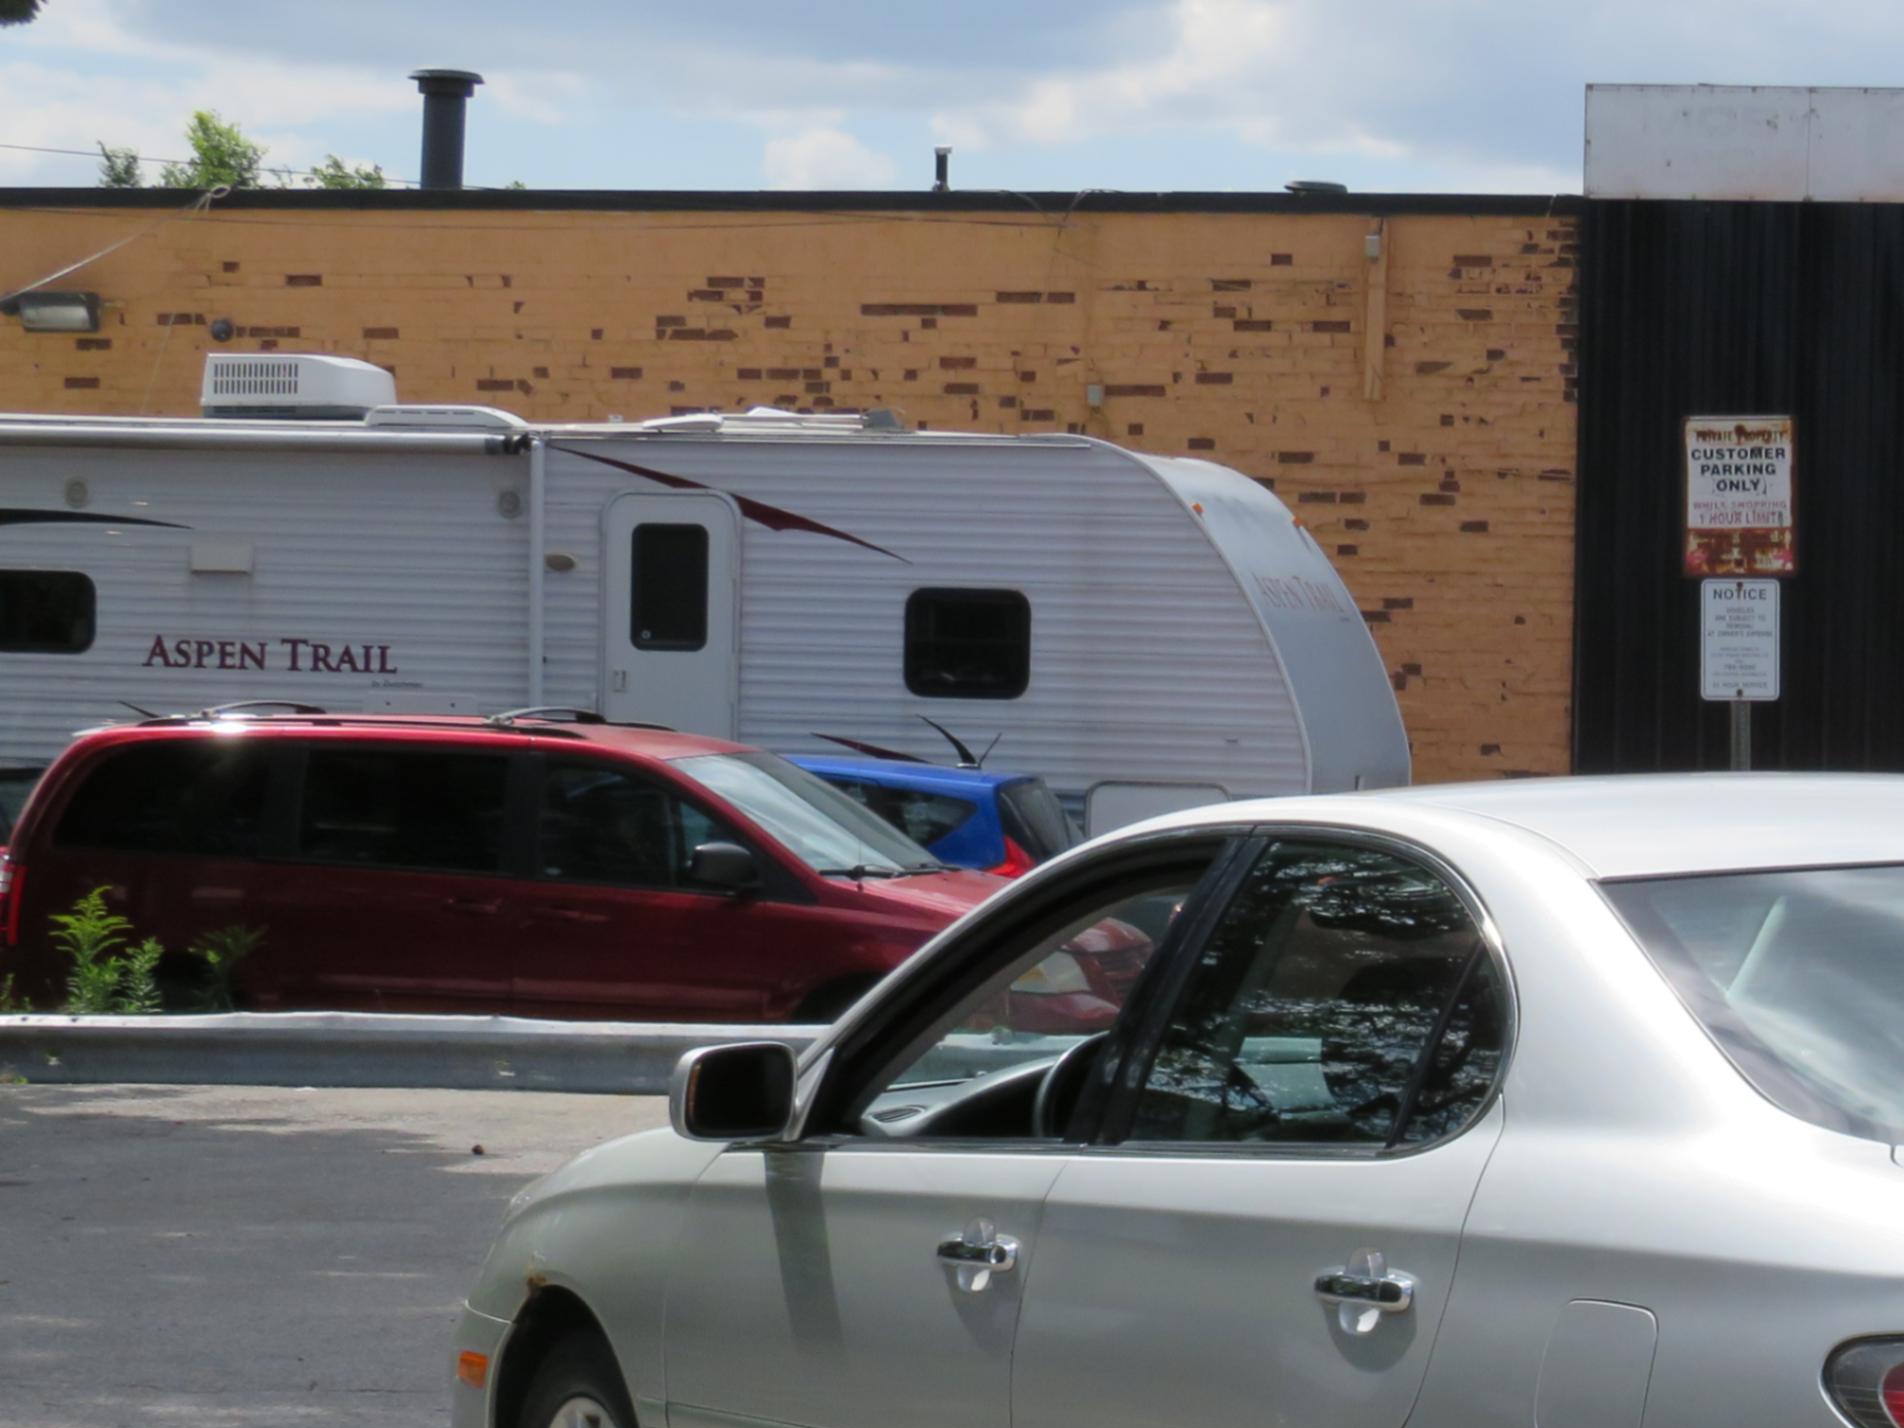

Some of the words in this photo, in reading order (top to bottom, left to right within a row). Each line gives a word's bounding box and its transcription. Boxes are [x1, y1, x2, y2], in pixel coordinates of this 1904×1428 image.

[1691, 447, 1786, 460] CUSTOMER
[1700, 463, 1776, 475] PARKING
[1715, 480, 1760, 492] ONLY
[1713, 588, 1767, 600] NOTICE
[142, 634, 268, 671] ASPEN
[280, 638, 397, 674] TRAIL
